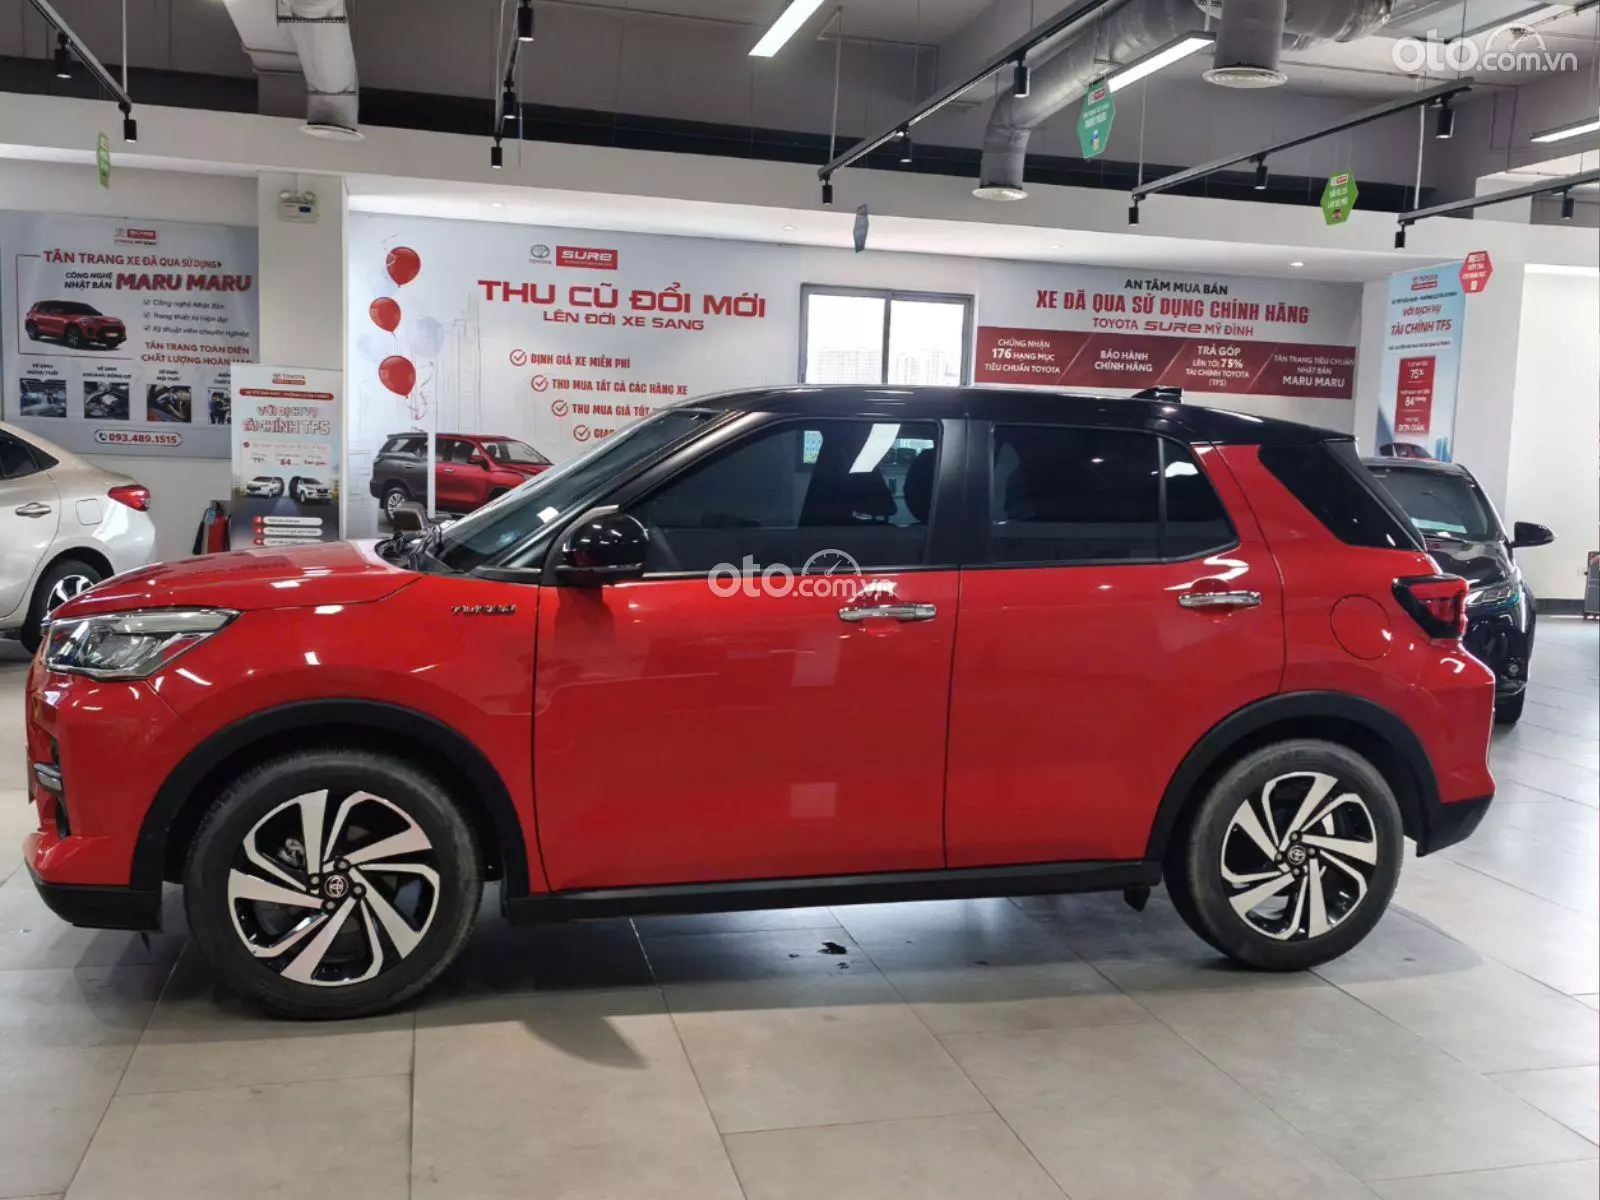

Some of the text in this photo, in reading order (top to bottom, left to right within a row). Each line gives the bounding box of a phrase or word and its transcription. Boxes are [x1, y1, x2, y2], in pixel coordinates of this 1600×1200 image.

[43, 248, 75, 264] TÂN
[78, 252, 124, 265] TRANG
[127, 256, 141, 266] XE
[142, 254, 158, 266] ĐÃ
[159, 257, 180, 268] QUA
[194, 260, 217, 270] DỤNG
[65, 270, 89, 278] CÔNG
[64, 280, 90, 291] NHẬT
[115, 273, 252, 292] MARU MARU
[1124, 278, 1228, 296] AN TÂM MUA BÁN
[478, 280, 766, 318] THU CŨ ĐỔI MỚI
[1036, 289, 1309, 324] XE ĐÃ QUA SỬ DỤNG CHÍNH HÃNG
[543, 308, 704, 330] LÊN ĐỜI XE SANG
[1092, 317, 1138, 330] TOYOTA
[1204, 322, 1222, 335] MỸ
[1224, 322, 1254, 336] ĐÌNH
[1405, 319, 1434, 334] CHÍNH
[1436, 318, 1452, 332] TFS
[166, 342, 198, 352] TRANG
[998, 338, 1050, 350] CHỨNG NHẬN
[1198, 343, 1241, 356] TRẢ GÓP
[992, 348, 1012, 358] 176
[1121, 350, 1149, 360] HÀNH
[168, 354, 201, 366] LƯỢNG
[530, 352, 630, 368] ĐỊNH GIÁ XE MIỄN PHÍ
[1094, 360, 1153, 372] CHÍNH HÃNG
[1192, 358, 1207, 367] LÊN
[1221, 360, 1244, 369] 75%
[1032, 366, 1061, 374] TOYOTA
[1222, 370, 1250, 378] TOYOTA
[552, 378, 570, 390] THU
[572, 380, 593, 391] MUA
[596, 378, 612, 392] TẤT
[629, 380, 647, 394] CÁC
[650, 382, 674, 395] HÃNG
[676, 384, 688, 396] XE
[1282, 376, 1345, 388] MARU MARU
[572, 404, 590, 414] THU
[592, 404, 613, 415] MUA
[616, 404, 631, 416] GIÁ
[303, 420, 330, 436] TFS
[109, 433, 177, 444] 093.489.1515
